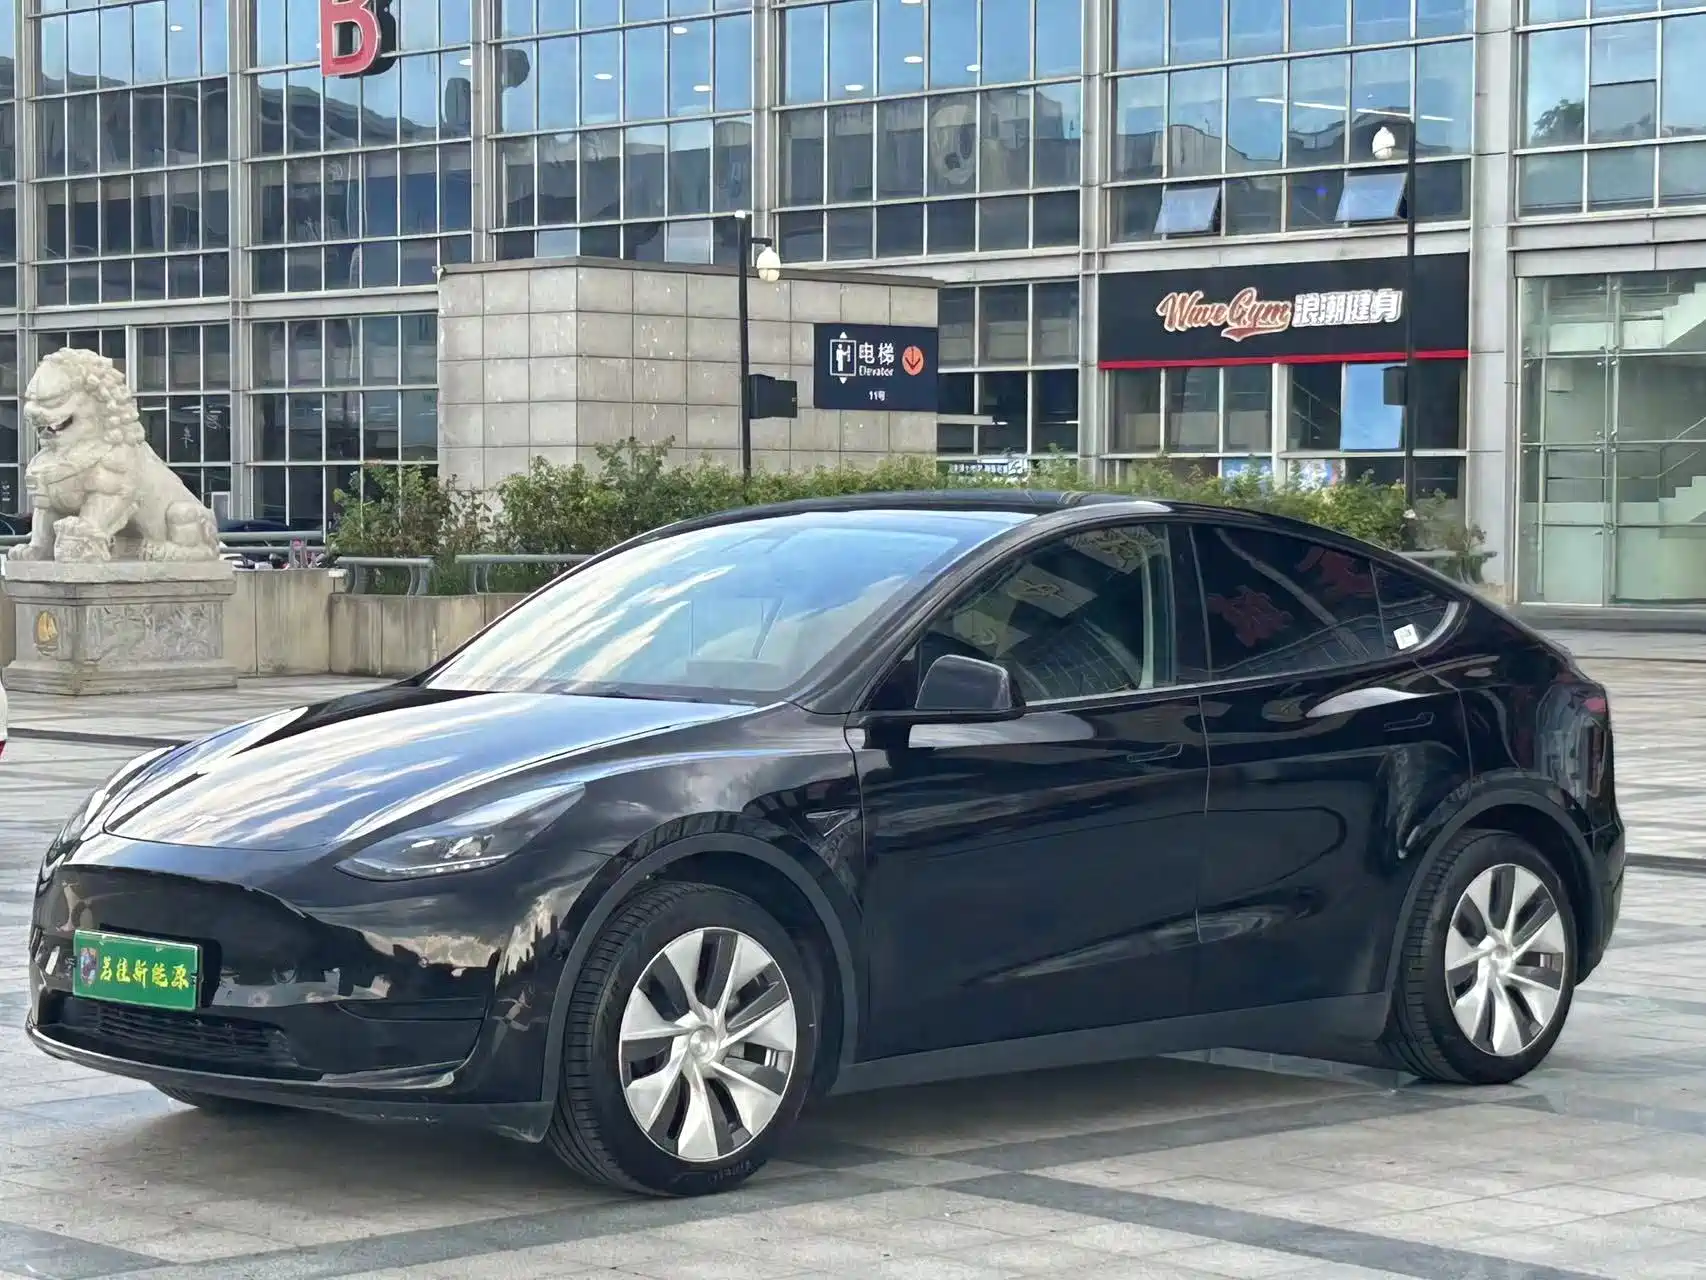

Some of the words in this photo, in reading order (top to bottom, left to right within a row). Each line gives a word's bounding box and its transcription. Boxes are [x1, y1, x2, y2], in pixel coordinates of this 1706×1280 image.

[1291, 288, 1403, 327] 浪潮健身
[858, 341, 895, 365] 电梯
